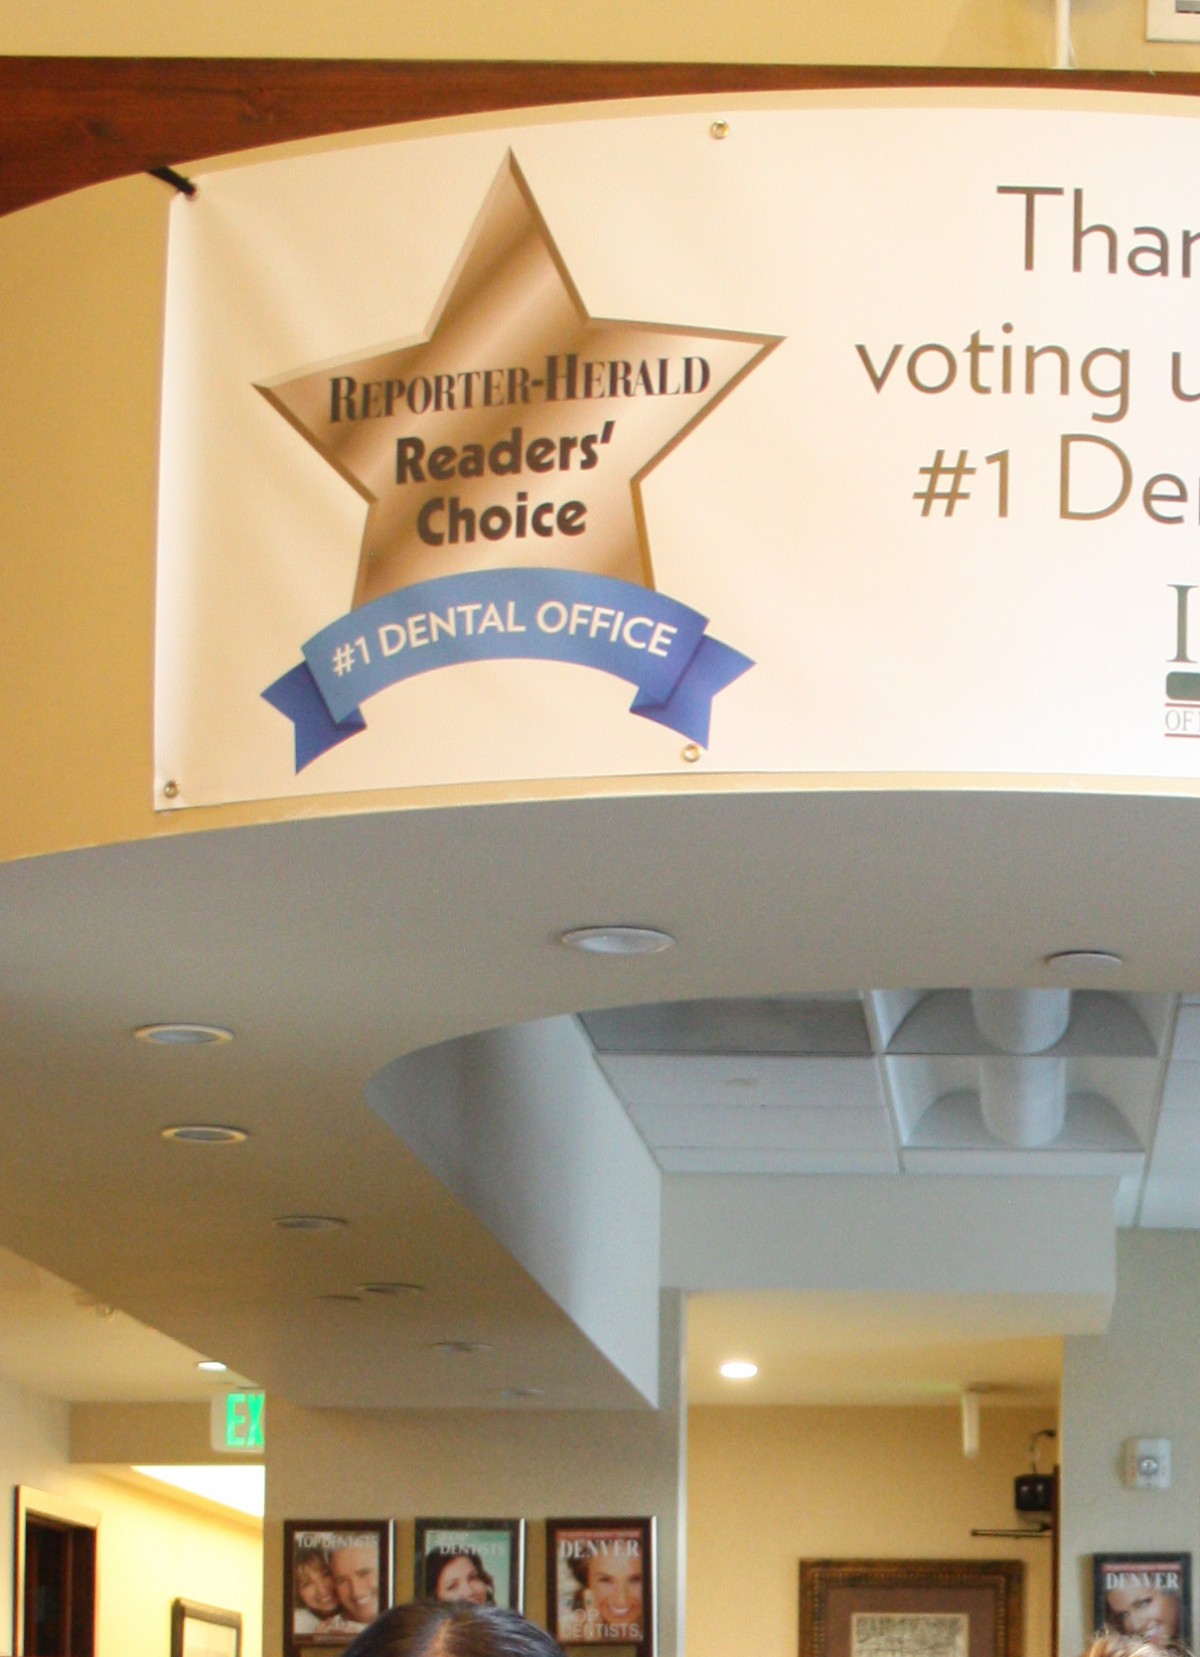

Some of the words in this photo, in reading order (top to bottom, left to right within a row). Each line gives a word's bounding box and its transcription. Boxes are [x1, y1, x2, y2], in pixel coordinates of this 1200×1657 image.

[328, 352, 712, 424] REPORTER-HERALD
[855, 322, 1132, 424] voting
[912, 448, 1011, 519] #1
[416, 491, 588, 547] Choice
[331, 636, 373, 678] #1
[378, 602, 527, 657] DENTAL
[535, 601, 679, 658] OFFICE
[1165, 709, 1195, 732] OF
[226, 1393, 265, 1447] EX
[560, 1539, 640, 1559] DENVER
[1105, 1572, 1180, 1591] DENVER
